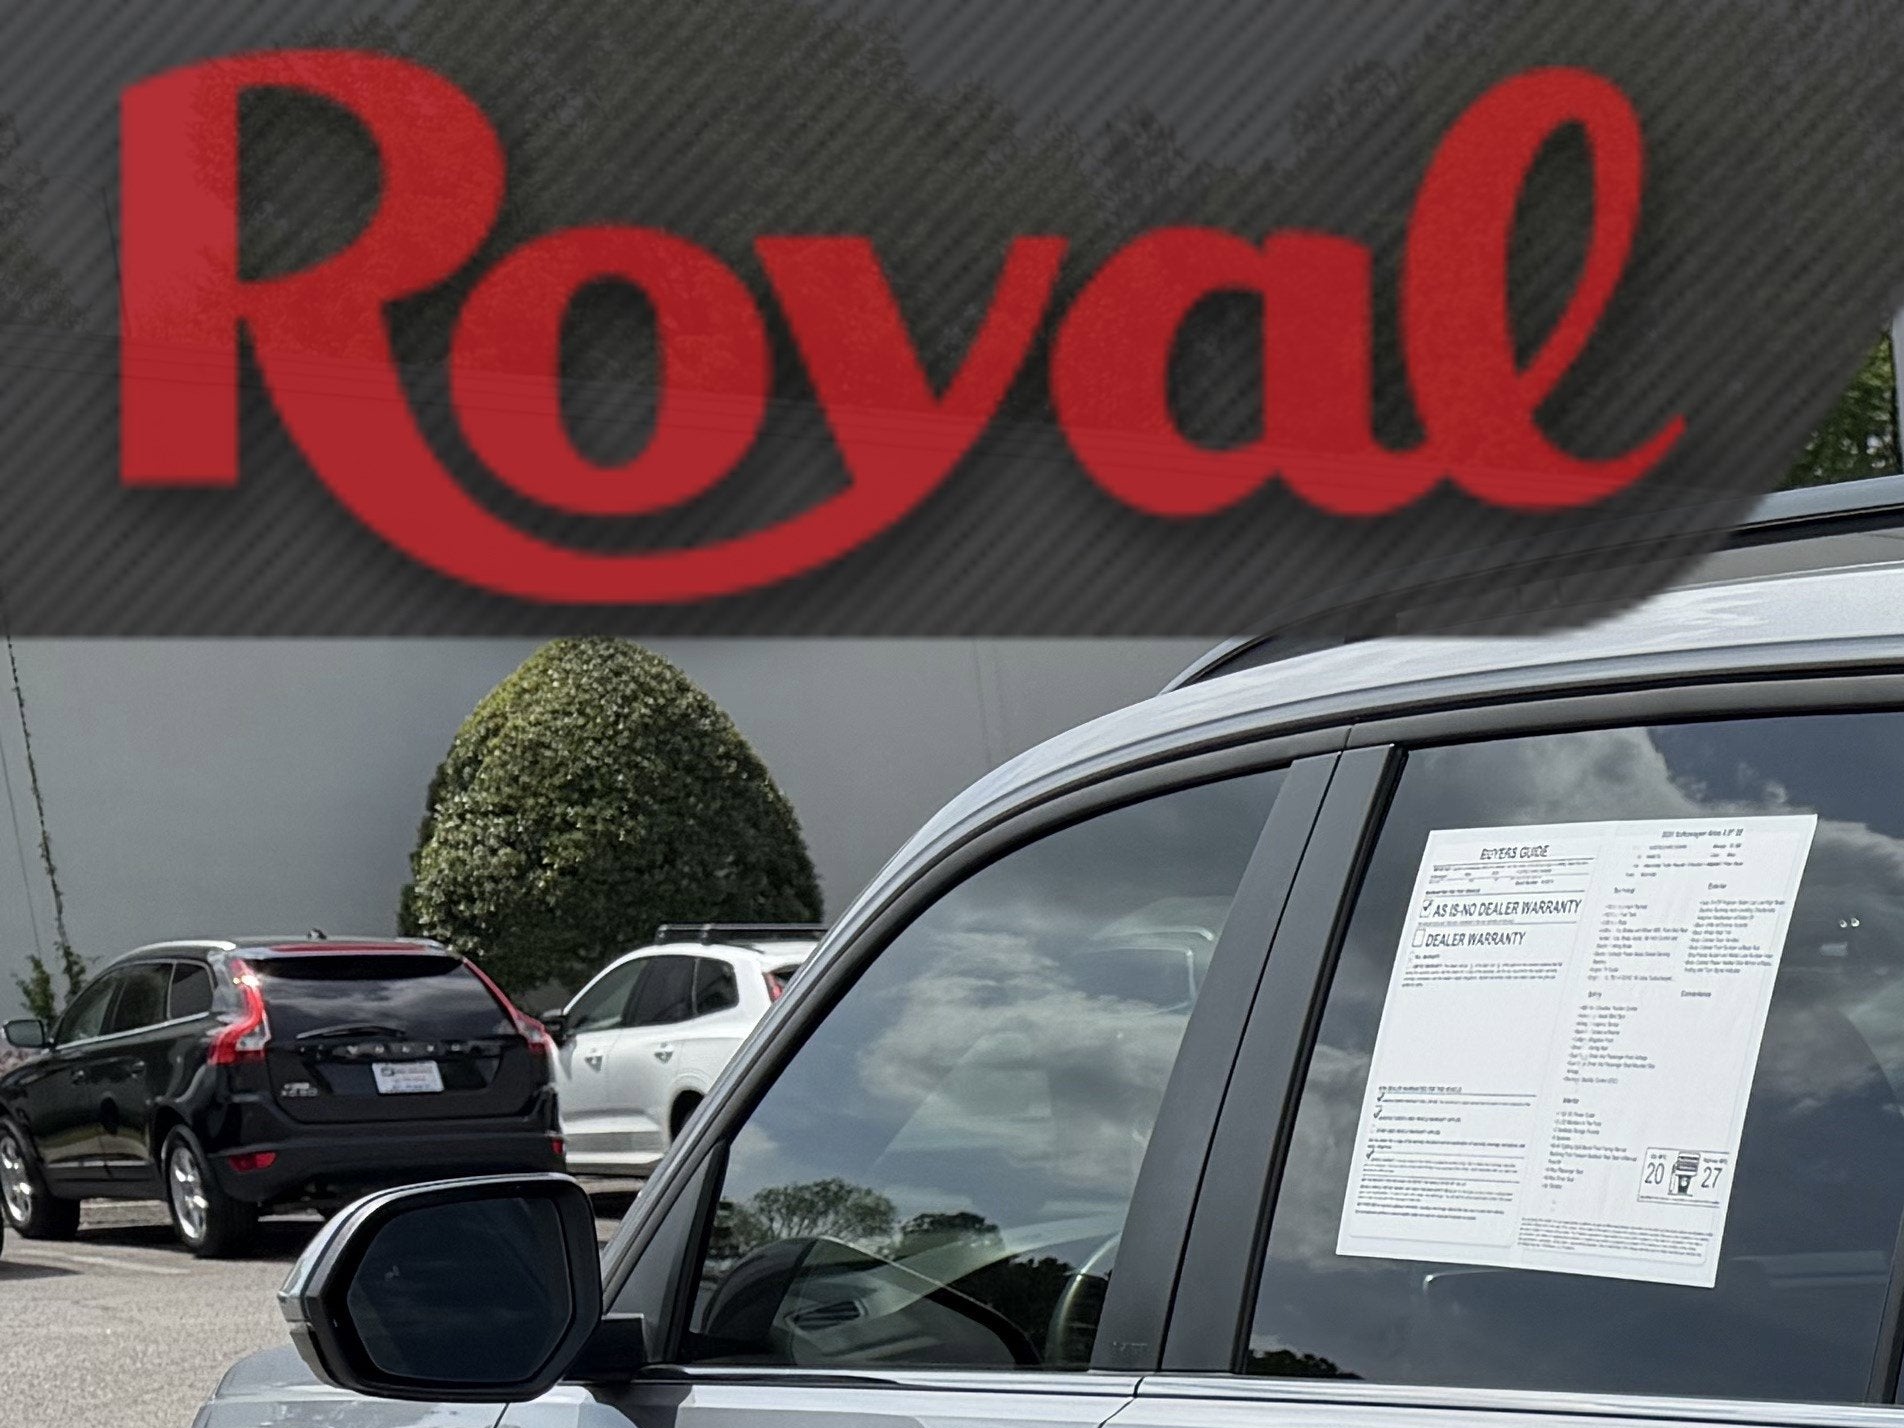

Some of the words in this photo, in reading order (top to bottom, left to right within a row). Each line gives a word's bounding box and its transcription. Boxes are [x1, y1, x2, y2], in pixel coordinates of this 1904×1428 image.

[1519, 845, 1549, 858] GUIDE
[1432, 904, 1448, 918] AS
[1478, 901, 1519, 916] DEALER
[1521, 899, 1582, 914] WARRANTY
[1425, 933, 1465, 947] DEALER
[1467, 931, 1526, 947] WARRANTY
[1644, 1162, 1665, 1184] 20
[1701, 1166, 1722, 1188] 27
